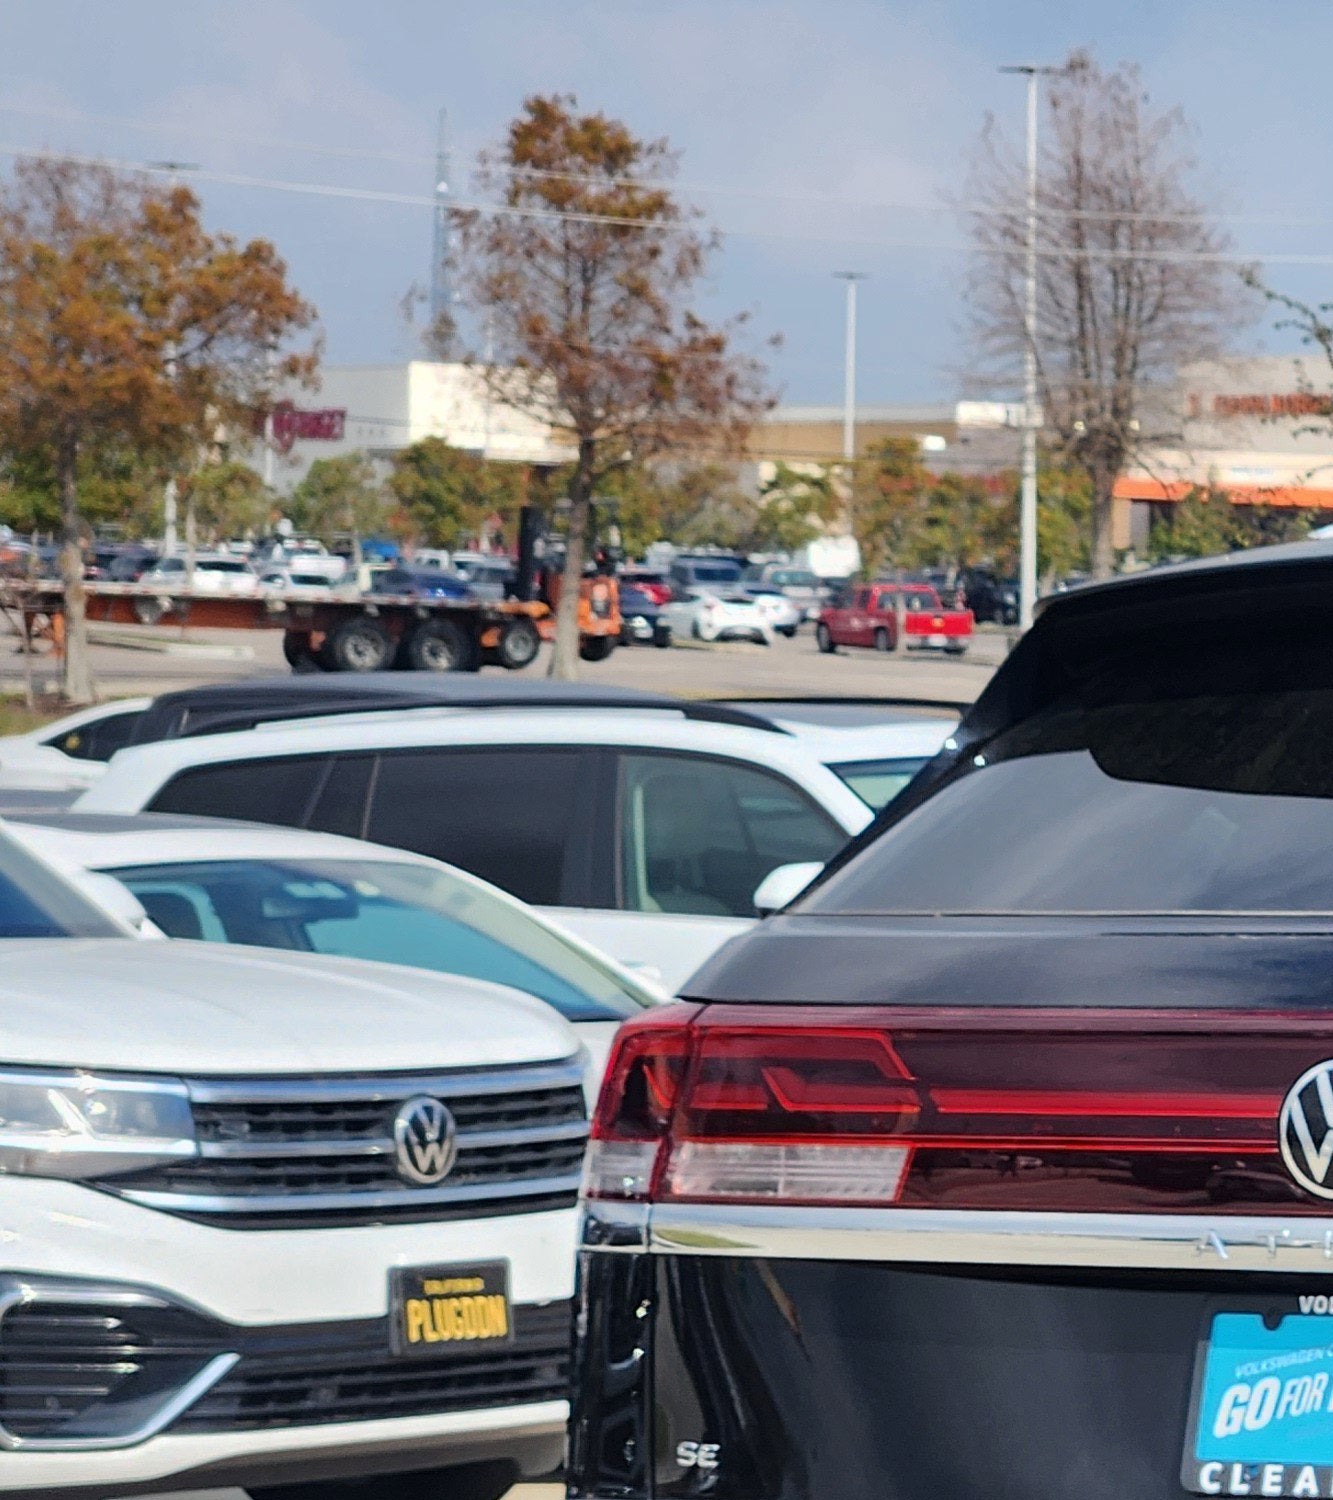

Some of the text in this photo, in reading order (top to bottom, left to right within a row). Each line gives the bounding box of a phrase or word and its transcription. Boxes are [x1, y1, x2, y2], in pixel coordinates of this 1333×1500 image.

[1213, 1376, 1281, 1438] GO
[1276, 1371, 1329, 1420] FOR
[676, 1441, 721, 1469] SE
